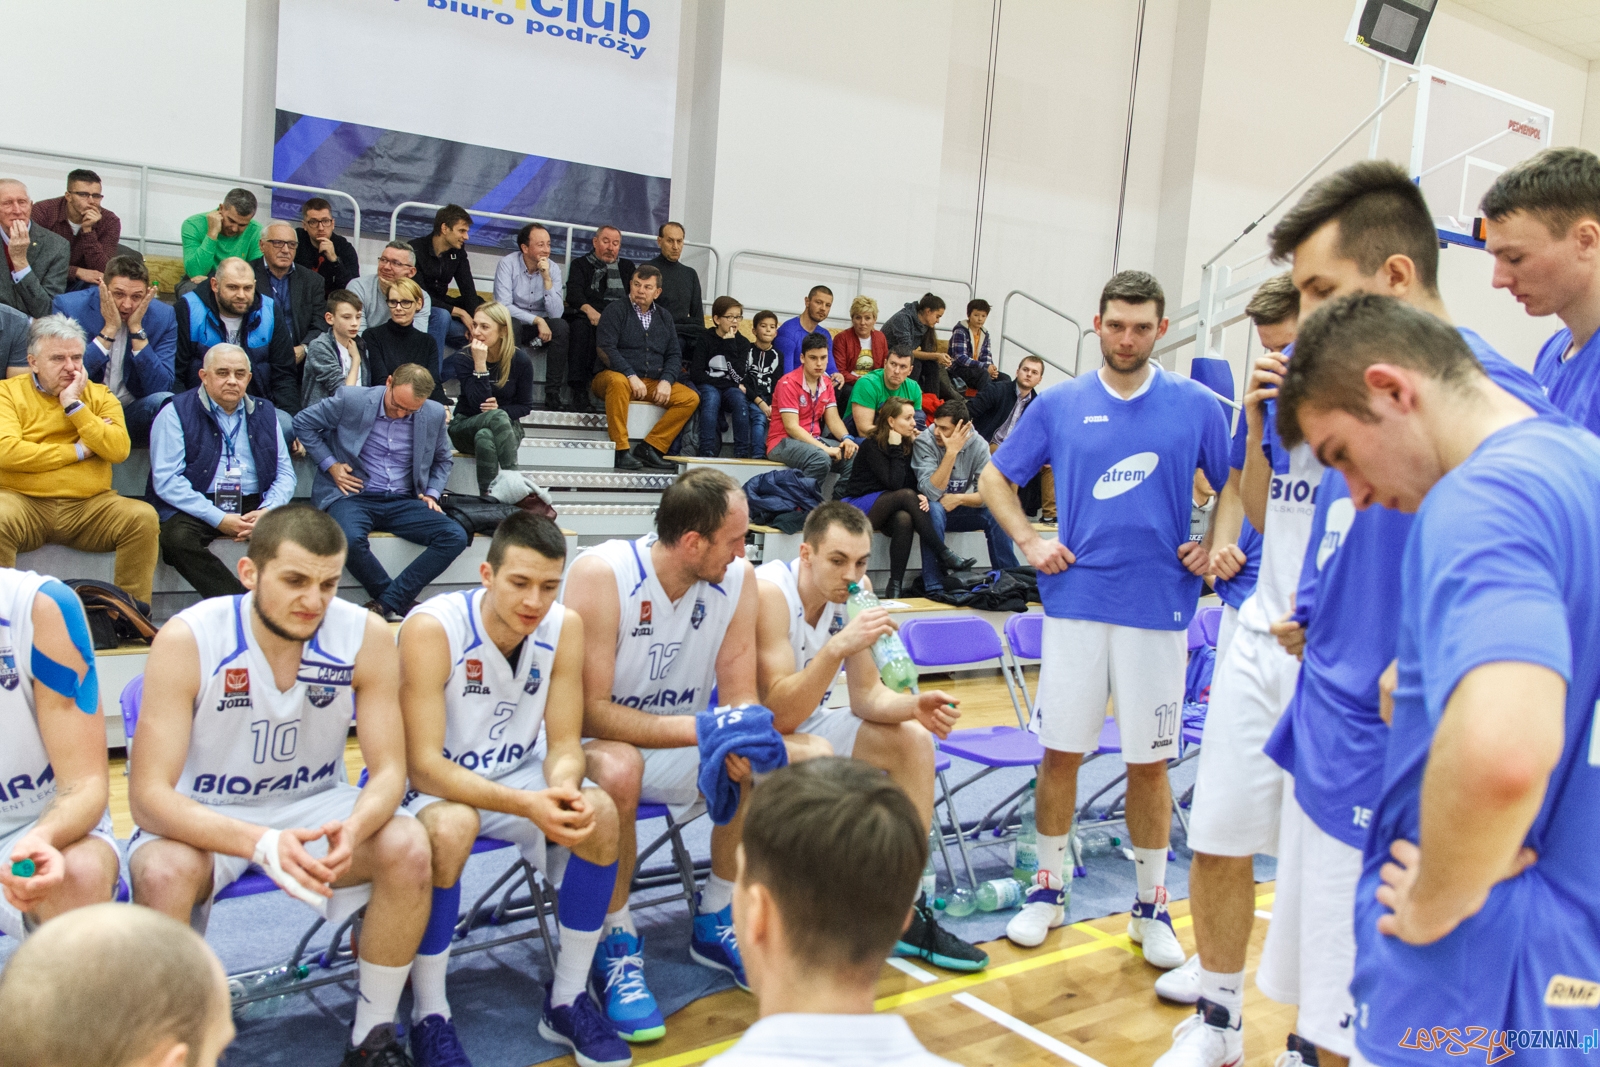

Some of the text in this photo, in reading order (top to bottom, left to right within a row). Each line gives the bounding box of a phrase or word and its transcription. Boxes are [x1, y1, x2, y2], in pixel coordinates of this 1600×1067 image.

[427, 0, 647, 60] biuro podróży
[1102, 468, 1146, 482] atrem
[1173, 611, 1182, 622] 11
[648, 642, 682, 681] 12
[489, 701, 518, 740] 2
[1155, 702, 1177, 738] 11
[251, 719, 301, 764] 10
[192, 760, 337, 795] BIOFARM
[1352, 805, 1373, 828] 15
